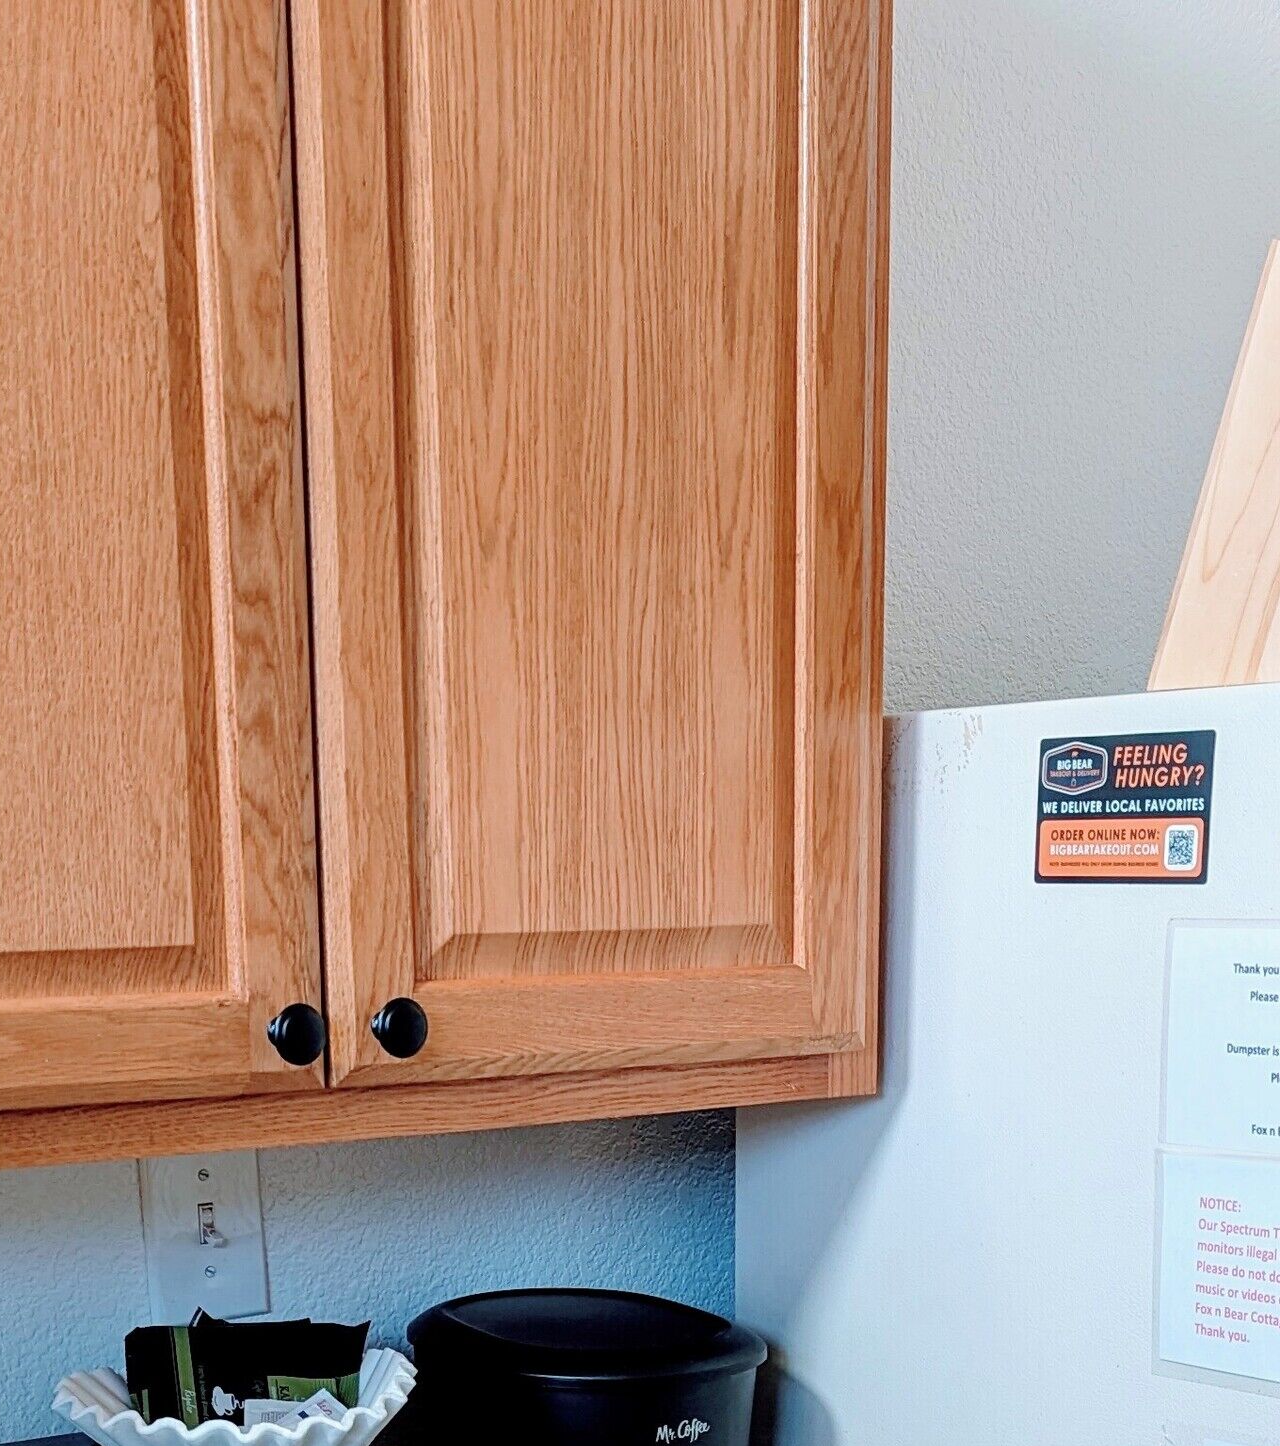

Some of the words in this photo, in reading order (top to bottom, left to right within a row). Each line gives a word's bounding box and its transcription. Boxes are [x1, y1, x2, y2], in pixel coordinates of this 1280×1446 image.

[1057, 759, 1071, 770] BIG
[1072, 758, 1093, 769] BEAR
[1113, 743, 1188, 767] FEELING
[1115, 764, 1205, 788] HUNGRY?
[1042, 802, 1057, 814] WE
[1061, 800, 1102, 813] DELIVER
[1105, 799, 1141, 812] LOCAL
[1145, 798, 1204, 812] FAVORITES
[1051, 829, 1084, 841] ORDER
[1087, 829, 1126, 841] ONLINE
[1130, 828, 1160, 840] NOW:
[1050, 843, 1159, 856] BIGBEARTAKEOUT.COM
[1233, 963, 1261, 975] Thank
[1262, 965, 1280, 976] you
[1250, 991, 1278, 1003] Please
[1227, 1044, 1270, 1057] Dumpster
[1272, 1045, 1280, 1056] is
[1251, 1124, 1268, 1136] Fox
[1270, 1128, 1275, 1136] n
[1199, 1196, 1241, 1213] NOTICE:
[1198, 1218, 1218, 1231] Our
[1220, 1221, 1270, 1238] Spectrum
[1197, 1240, 1244, 1256] monitors
[1246, 1245, 1278, 1261] illegal
[1196, 1260, 1229, 1276] Please
[1231, 1264, 1245, 1278] do
[1248, 1267, 1267, 1281] not
[1195, 1283, 1226, 1298] music
[1227, 1289, 1239, 1299] or
[1241, 1289, 1276, 1305] videos
[1195, 1302, 1213, 1315] Fox
[1215, 1308, 1221, 1317] n
[1224, 1307, 1248, 1322] Bear
[1195, 1323, 1226, 1339] Thank
[1228, 1329, 1250, 1343] you.
[656, 1425, 676, 1444] Mr.
[678, 1418, 710, 1443] Coffee
